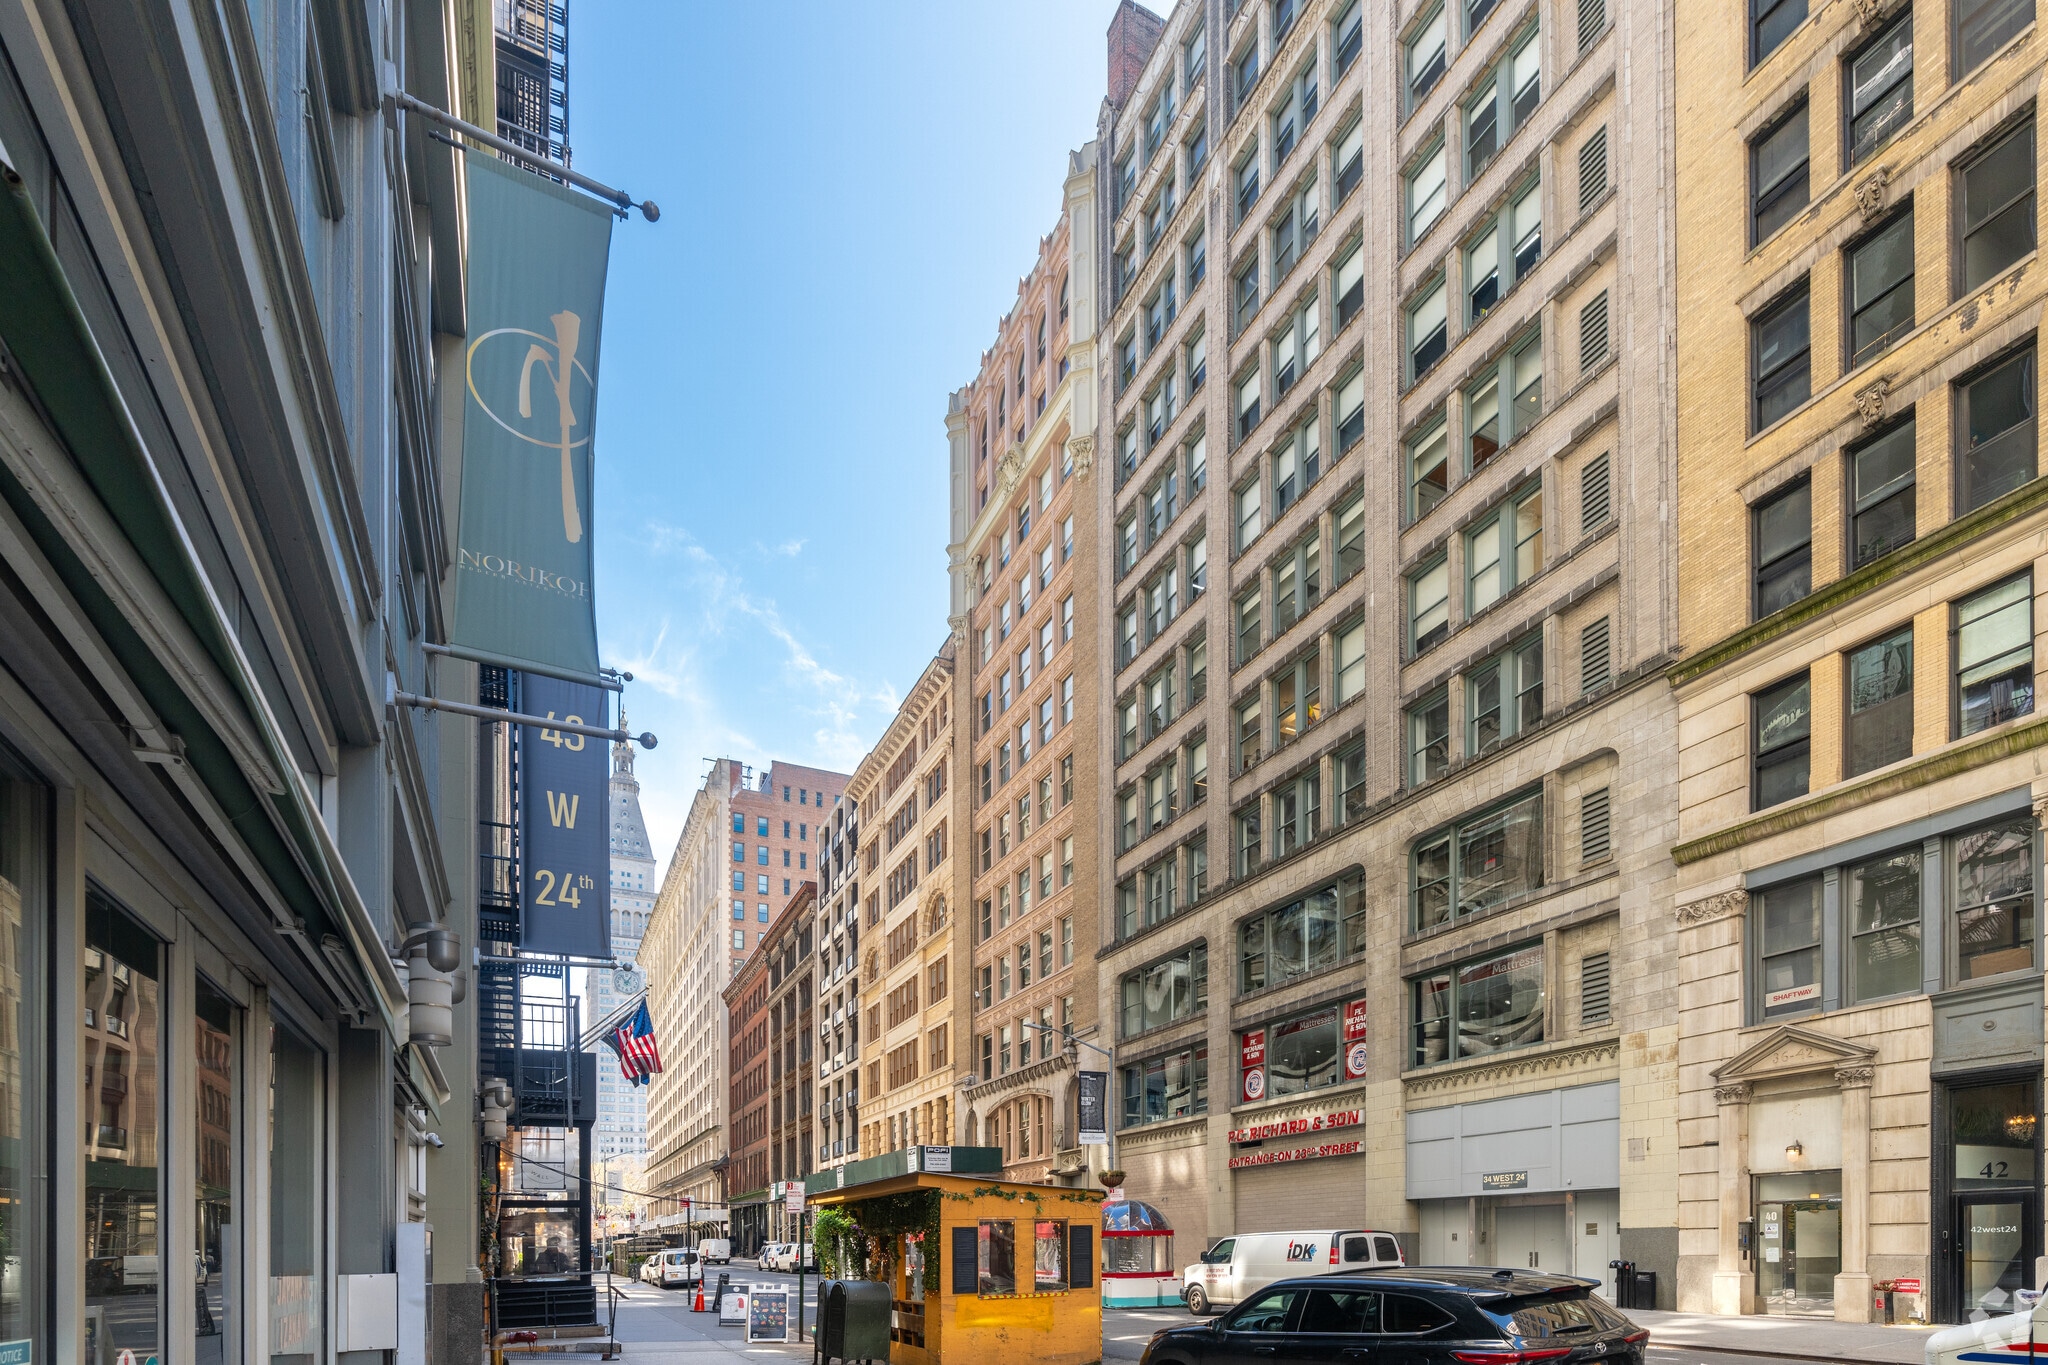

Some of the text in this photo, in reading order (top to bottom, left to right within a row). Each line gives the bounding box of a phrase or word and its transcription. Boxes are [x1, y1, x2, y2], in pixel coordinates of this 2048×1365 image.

[540, 711, 585, 751] 43
[547, 790, 579, 829] W
[1773, 988, 1813, 1002] SHAFTWAY
[1249, 1119, 1308, 1140] RICHARD
[1312, 1116, 1322, 1130] &
[1327, 1110, 1359, 1129] SON
[1228, 1152, 1275, 1168] ENTRANCE
[1277, 1151, 1292, 1162] ON
[1319, 1141, 1360, 1157] STREET
[1980, 1161, 2008, 1178] 42
[1483, 1175, 1492, 1183] 34
[1492, 1174, 1515, 1182] WEST
[1766, 1211, 1778, 1221] 40
[1970, 1225, 2017, 1233] 42west24
